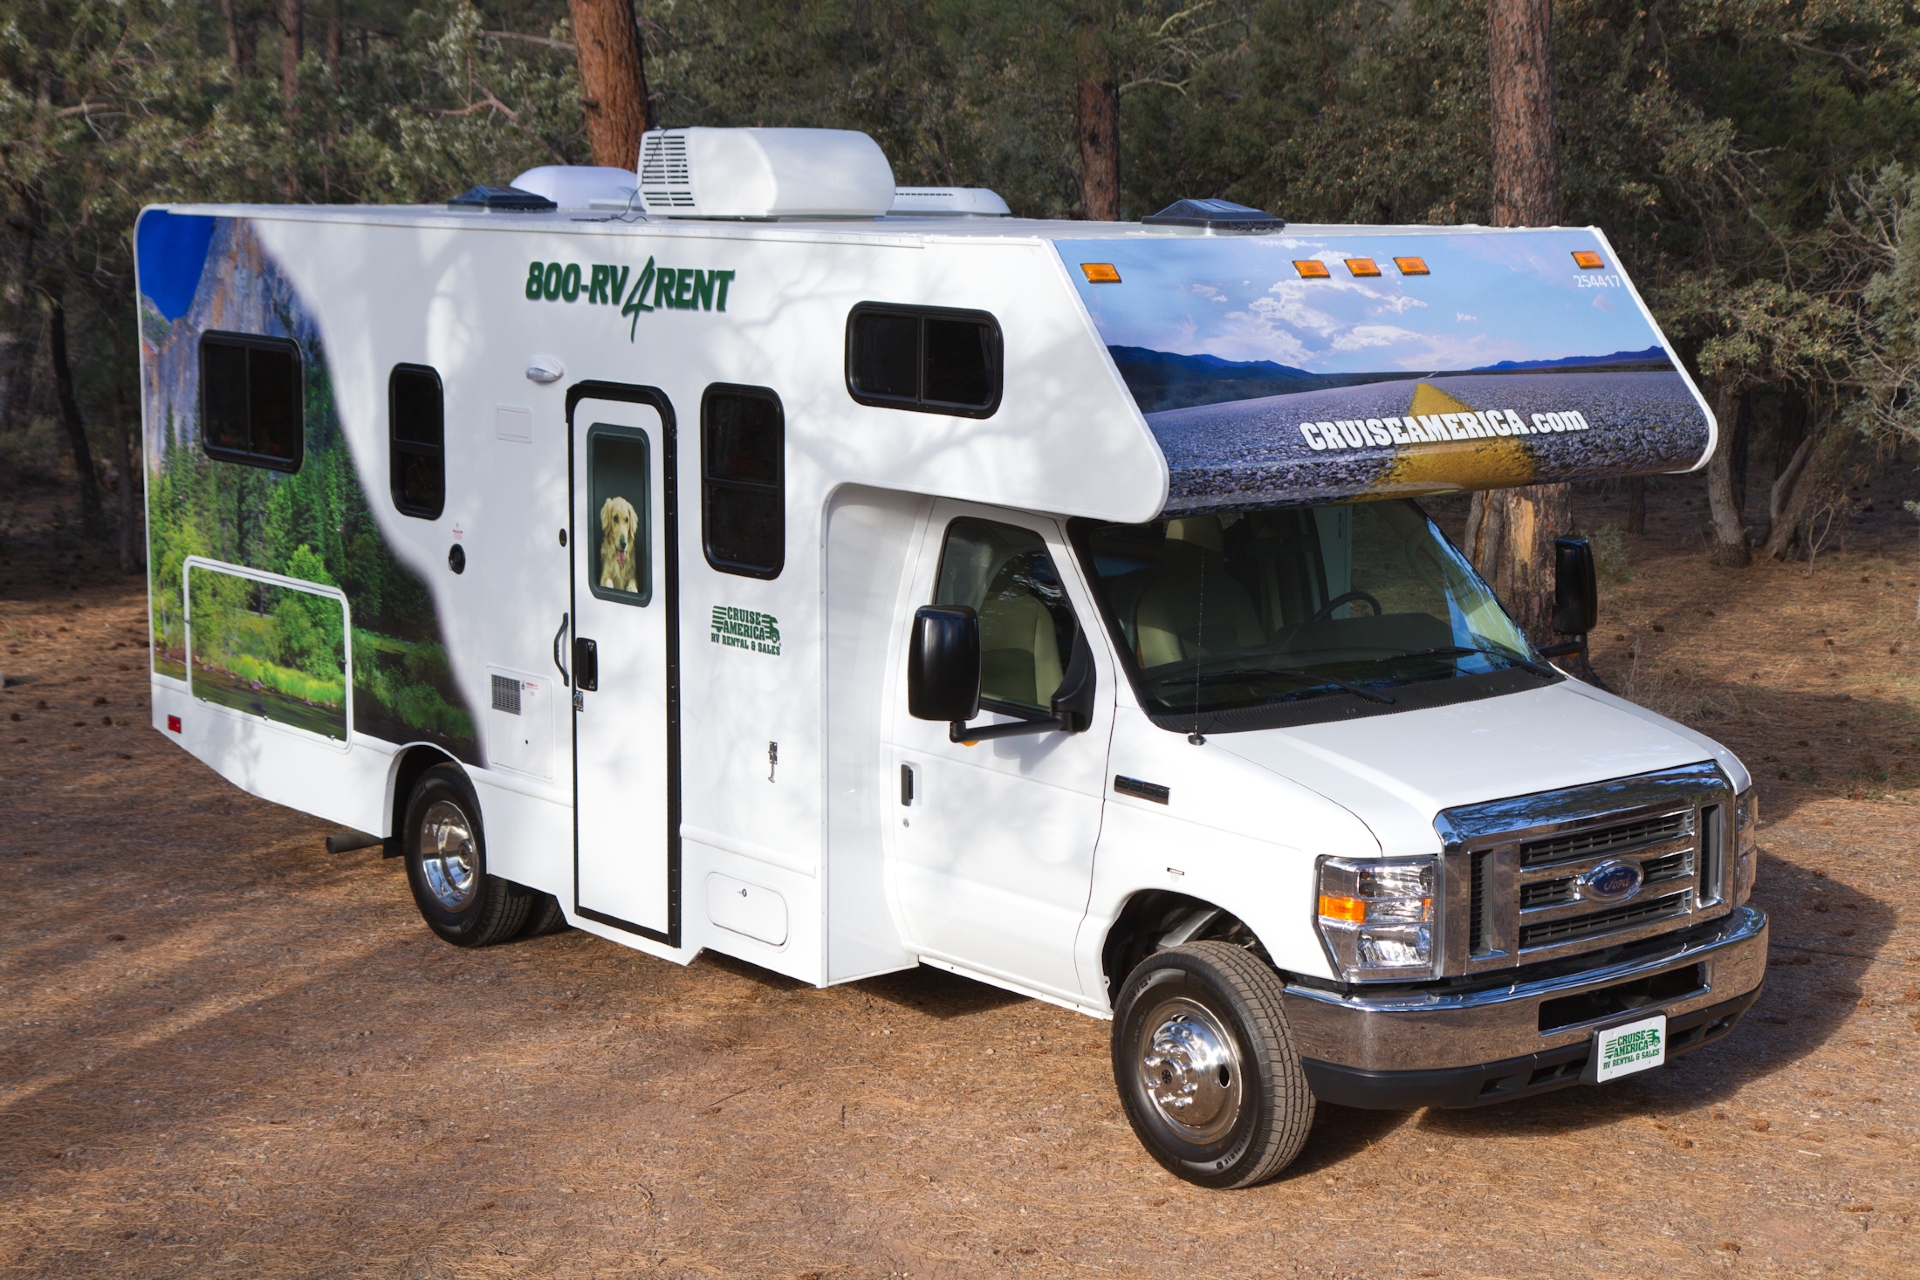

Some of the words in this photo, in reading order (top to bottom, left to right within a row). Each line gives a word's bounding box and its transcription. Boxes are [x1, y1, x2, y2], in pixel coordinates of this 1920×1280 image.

[1573, 275, 1621, 288] 254417
[1300, 409, 1589, 450] CRUISEAMERICA.com
[727, 606, 761, 626] CRUISE
[723, 620, 765, 641] AMERICA
[711, 632, 720, 643] RV
[722, 634, 749, 650] RENTAL
[751, 640, 756, 651] &
[757, 642, 780, 656] SALES
[1604, 873, 1631, 891] Ford
[1617, 1030, 1646, 1046] CRUISE
[1614, 1040, 1648, 1057] AMERICA
[1603, 1061, 1611, 1070] RV
[1612, 1055, 1634, 1067] RENTAL
[1641, 1048, 1660, 1059] SALES
